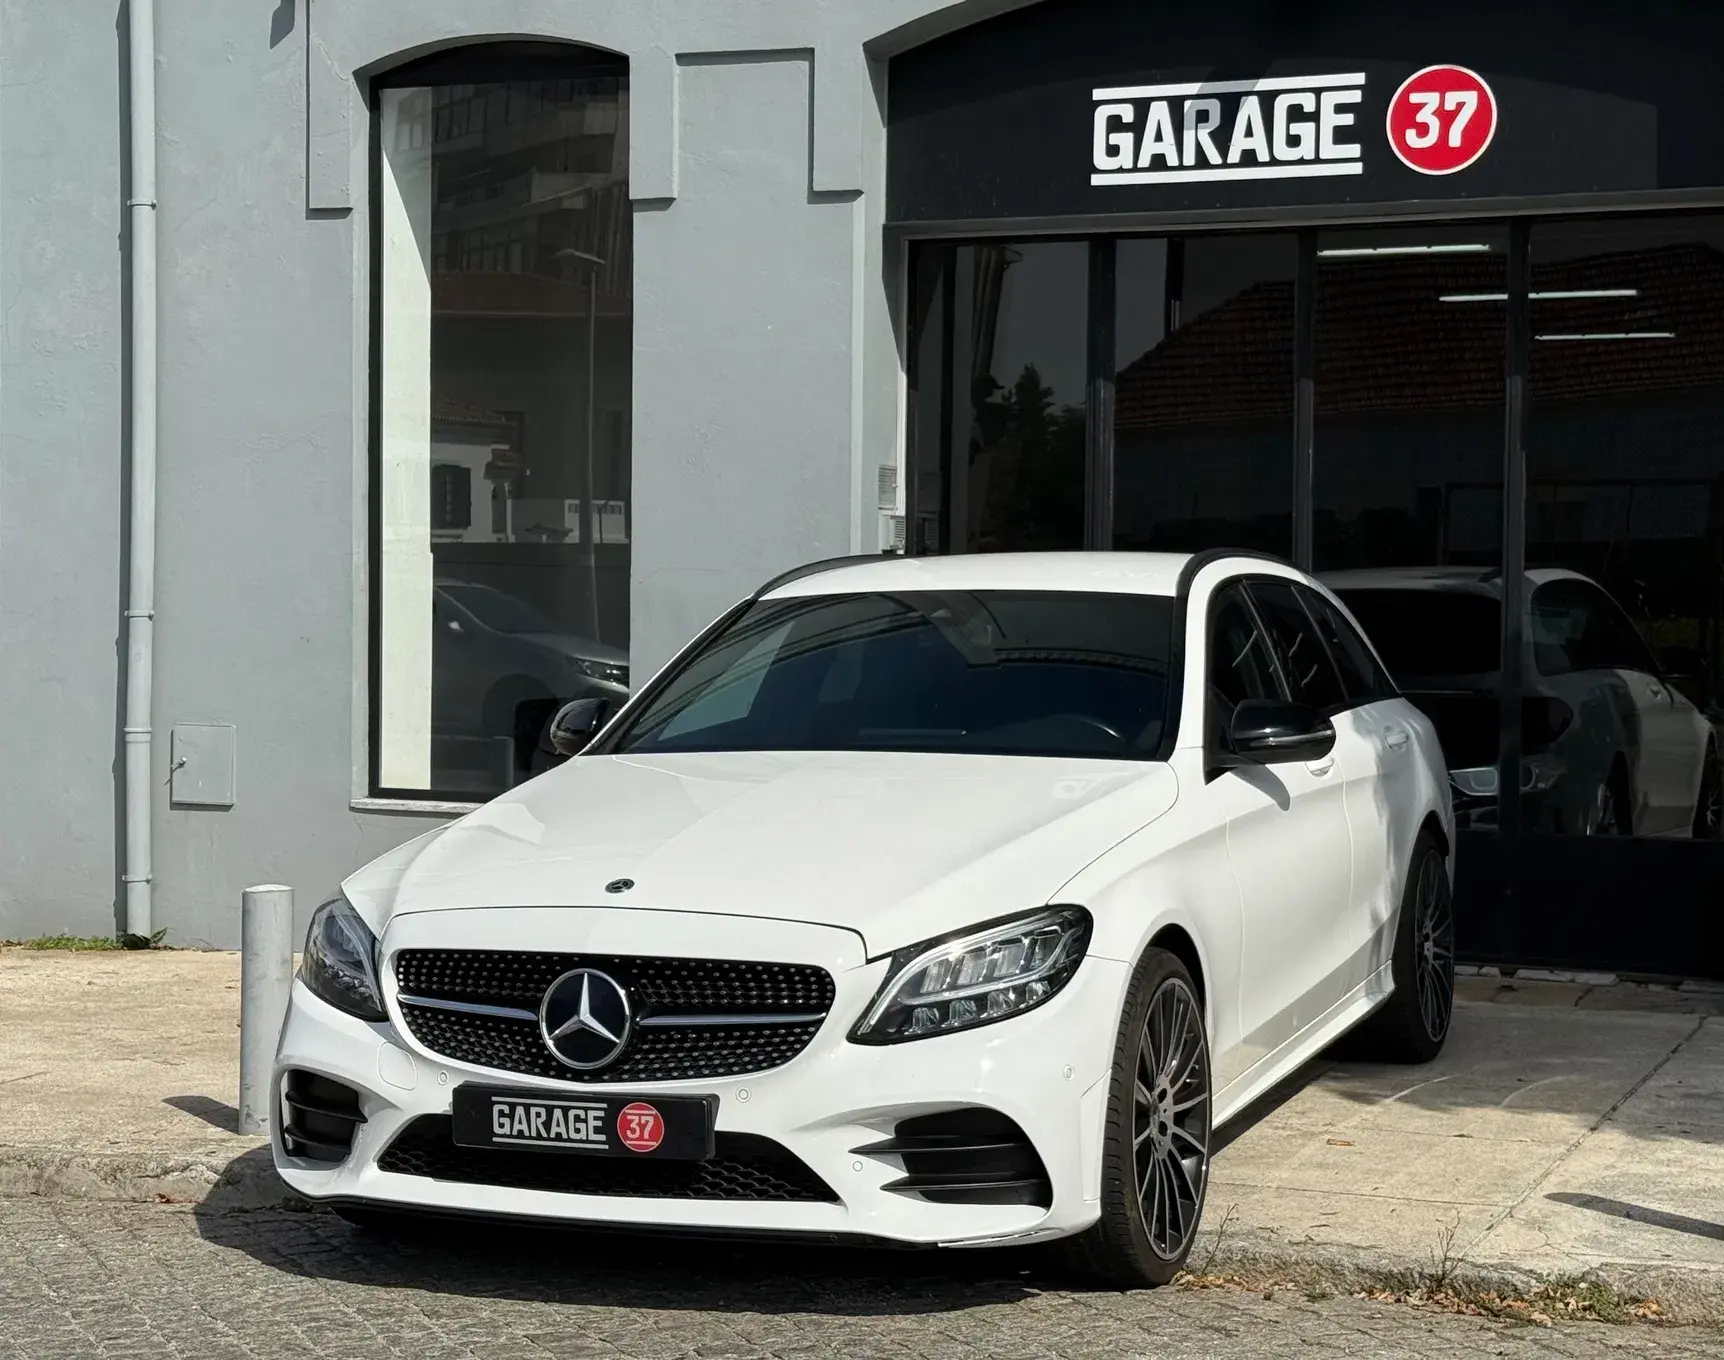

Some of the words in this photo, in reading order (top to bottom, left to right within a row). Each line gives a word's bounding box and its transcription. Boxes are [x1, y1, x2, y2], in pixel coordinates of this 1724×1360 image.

[1093, 90, 1362, 170] GARAGE
[1404, 90, 1478, 149] 37
[492, 1103, 607, 1142] GARAGE
[625, 1115, 655, 1140] 37
